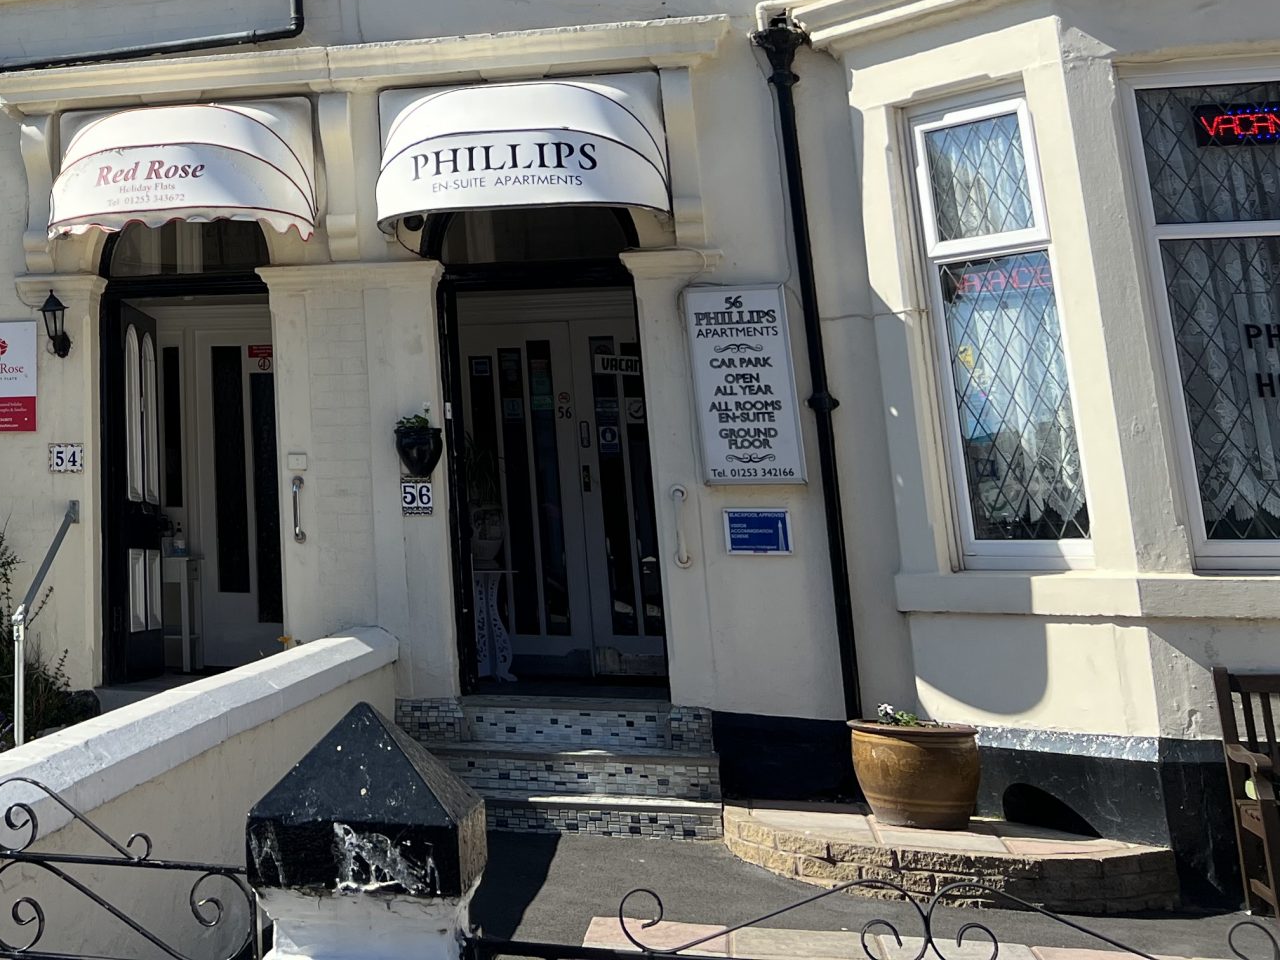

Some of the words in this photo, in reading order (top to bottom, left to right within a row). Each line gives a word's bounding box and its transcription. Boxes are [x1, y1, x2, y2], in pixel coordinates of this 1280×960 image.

[411, 141, 597, 181] PHILLIPS
[95, 161, 140, 187] Red
[145, 160, 205, 180] Rose
[119, 182, 152, 195] Holiday
[154, 181, 176, 192] Flats
[432, 177, 487, 193] EN-SUITE
[494, 175, 583, 187] APARTMENTS
[724, 295, 743, 310] 56
[694, 309, 777, 326] PHILLIPS
[696, 326, 778, 338] APARTMENTS
[0, 363, 24, 374] Rose
[709, 358, 737, 369] CAR
[739, 357, 773, 368] PARK
[724, 373, 760, 384] OPEN
[714, 385, 738, 396] ALL
[739, 384, 774, 395] YEAR
[709, 401, 732, 412] ALL
[734, 400, 782, 411] ROOMS
[558, 406, 572, 419] 56
[718, 411, 776, 423] EN-SUITE
[719, 427, 778, 439] GROUND
[728, 439, 772, 449] FLOOR
[55, 450, 78, 467] 54
[711, 469, 727, 478] Tel.
[731, 468, 758, 478] 01253
[761, 467, 795, 477] 342166
[402, 485, 431, 505] 56
